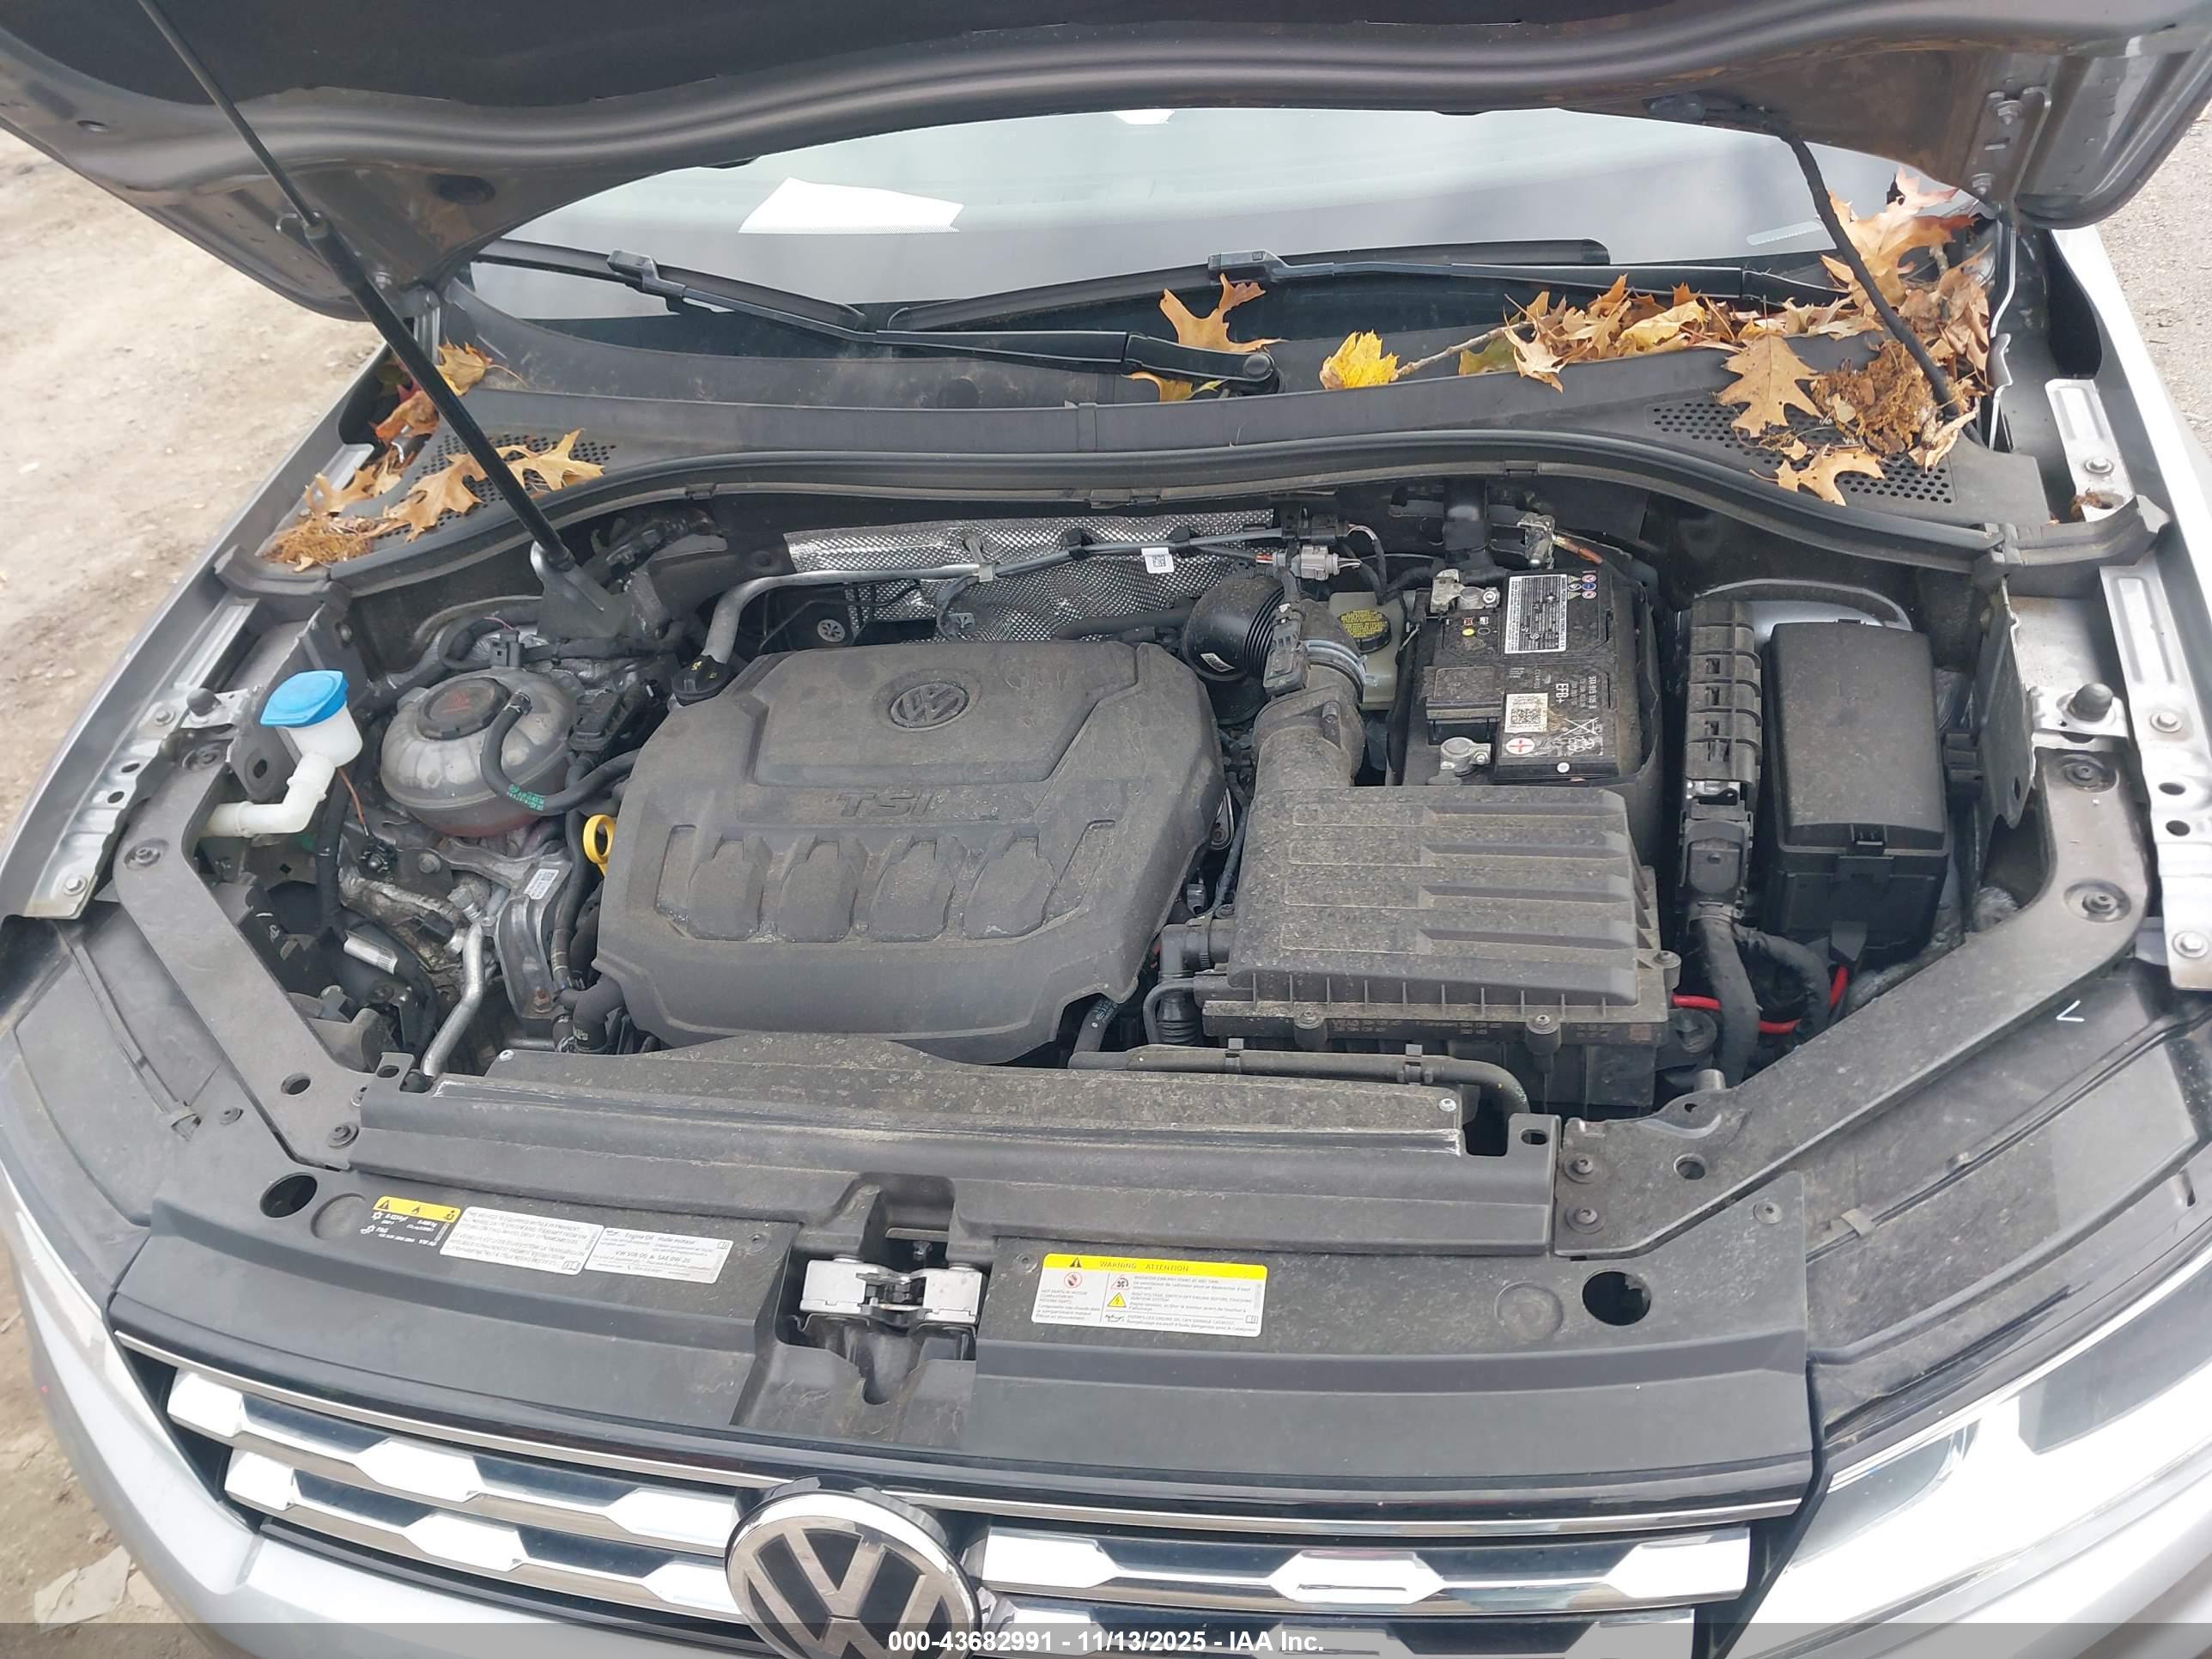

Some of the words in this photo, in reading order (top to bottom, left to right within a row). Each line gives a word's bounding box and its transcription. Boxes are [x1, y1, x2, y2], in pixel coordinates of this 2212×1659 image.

[1555, 683, 1570, 704] EFB+
[836, 792, 935, 817] TSI
[1099, 1261, 1137, 1269] WARNING
[1145, 1263, 1189, 1272] ATTENTION
